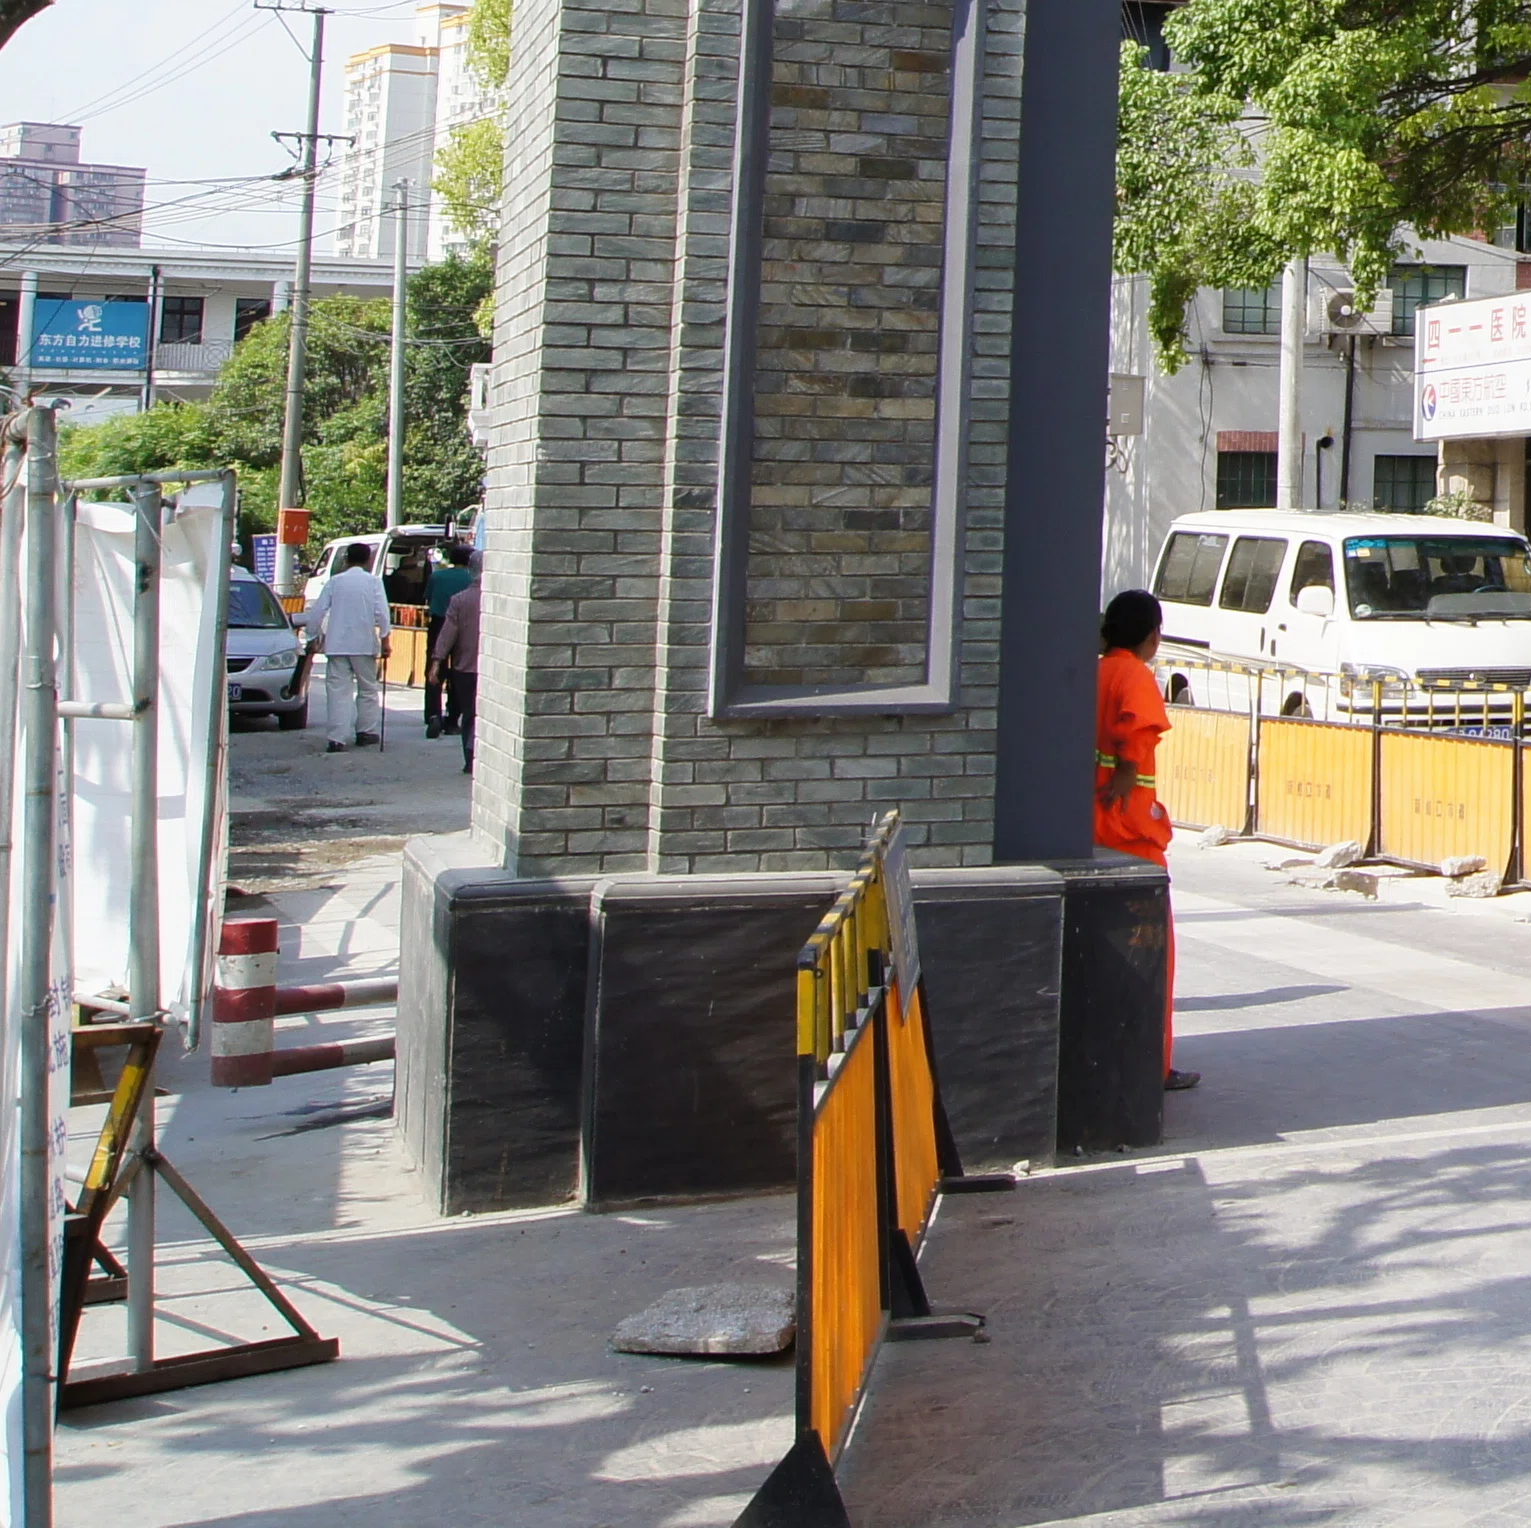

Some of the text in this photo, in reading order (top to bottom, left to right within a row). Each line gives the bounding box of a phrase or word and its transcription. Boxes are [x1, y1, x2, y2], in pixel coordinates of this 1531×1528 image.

[39, 334, 141, 348] 东方自力进修学校
[1428, 304, 1528, 352] 四一一医院
[1439, 372, 1507, 405] 中國東方航空
